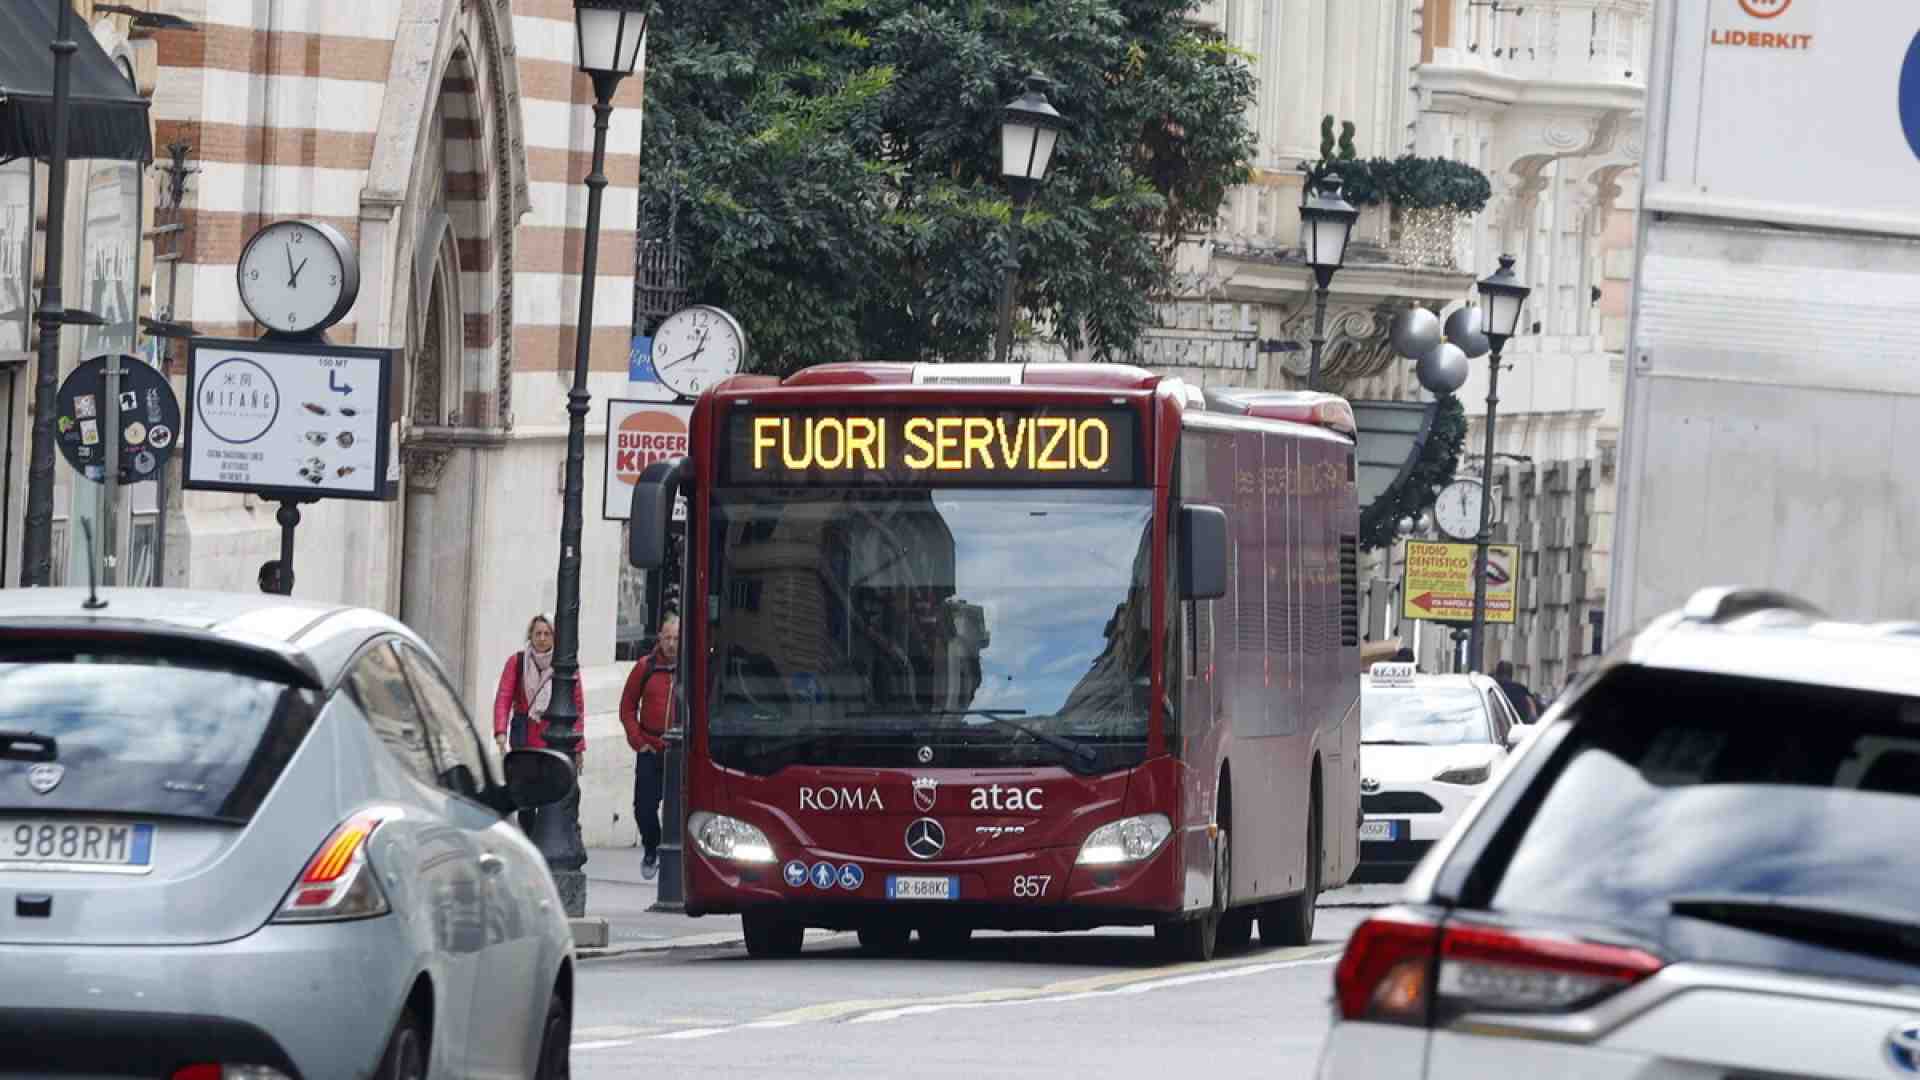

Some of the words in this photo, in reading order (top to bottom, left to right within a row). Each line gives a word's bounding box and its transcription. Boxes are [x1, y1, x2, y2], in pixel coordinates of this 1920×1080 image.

[1711, 29, 1813, 50] LIDERKIT
[290, 231, 303, 243] 12
[250, 269, 259, 281] 9
[328, 274, 337, 286] 3
[287, 312, 297, 323] 6
[691, 312, 708, 328] 12
[657, 343, 668, 357] 9
[727, 347, 737, 362] 3
[617, 432, 687, 451] BURGER
[754, 417, 885, 469] FUORI
[904, 417, 1109, 470] SERVIZIO
[1410, 544, 1448, 556] STUDIO
[1409, 556, 1468, 569] DENTISTICO
[800, 787, 884, 810] ROMA
[970, 784, 1043, 810] atac
[14, 824, 128, 859] 988RM
[1013, 875, 1051, 897] 857
